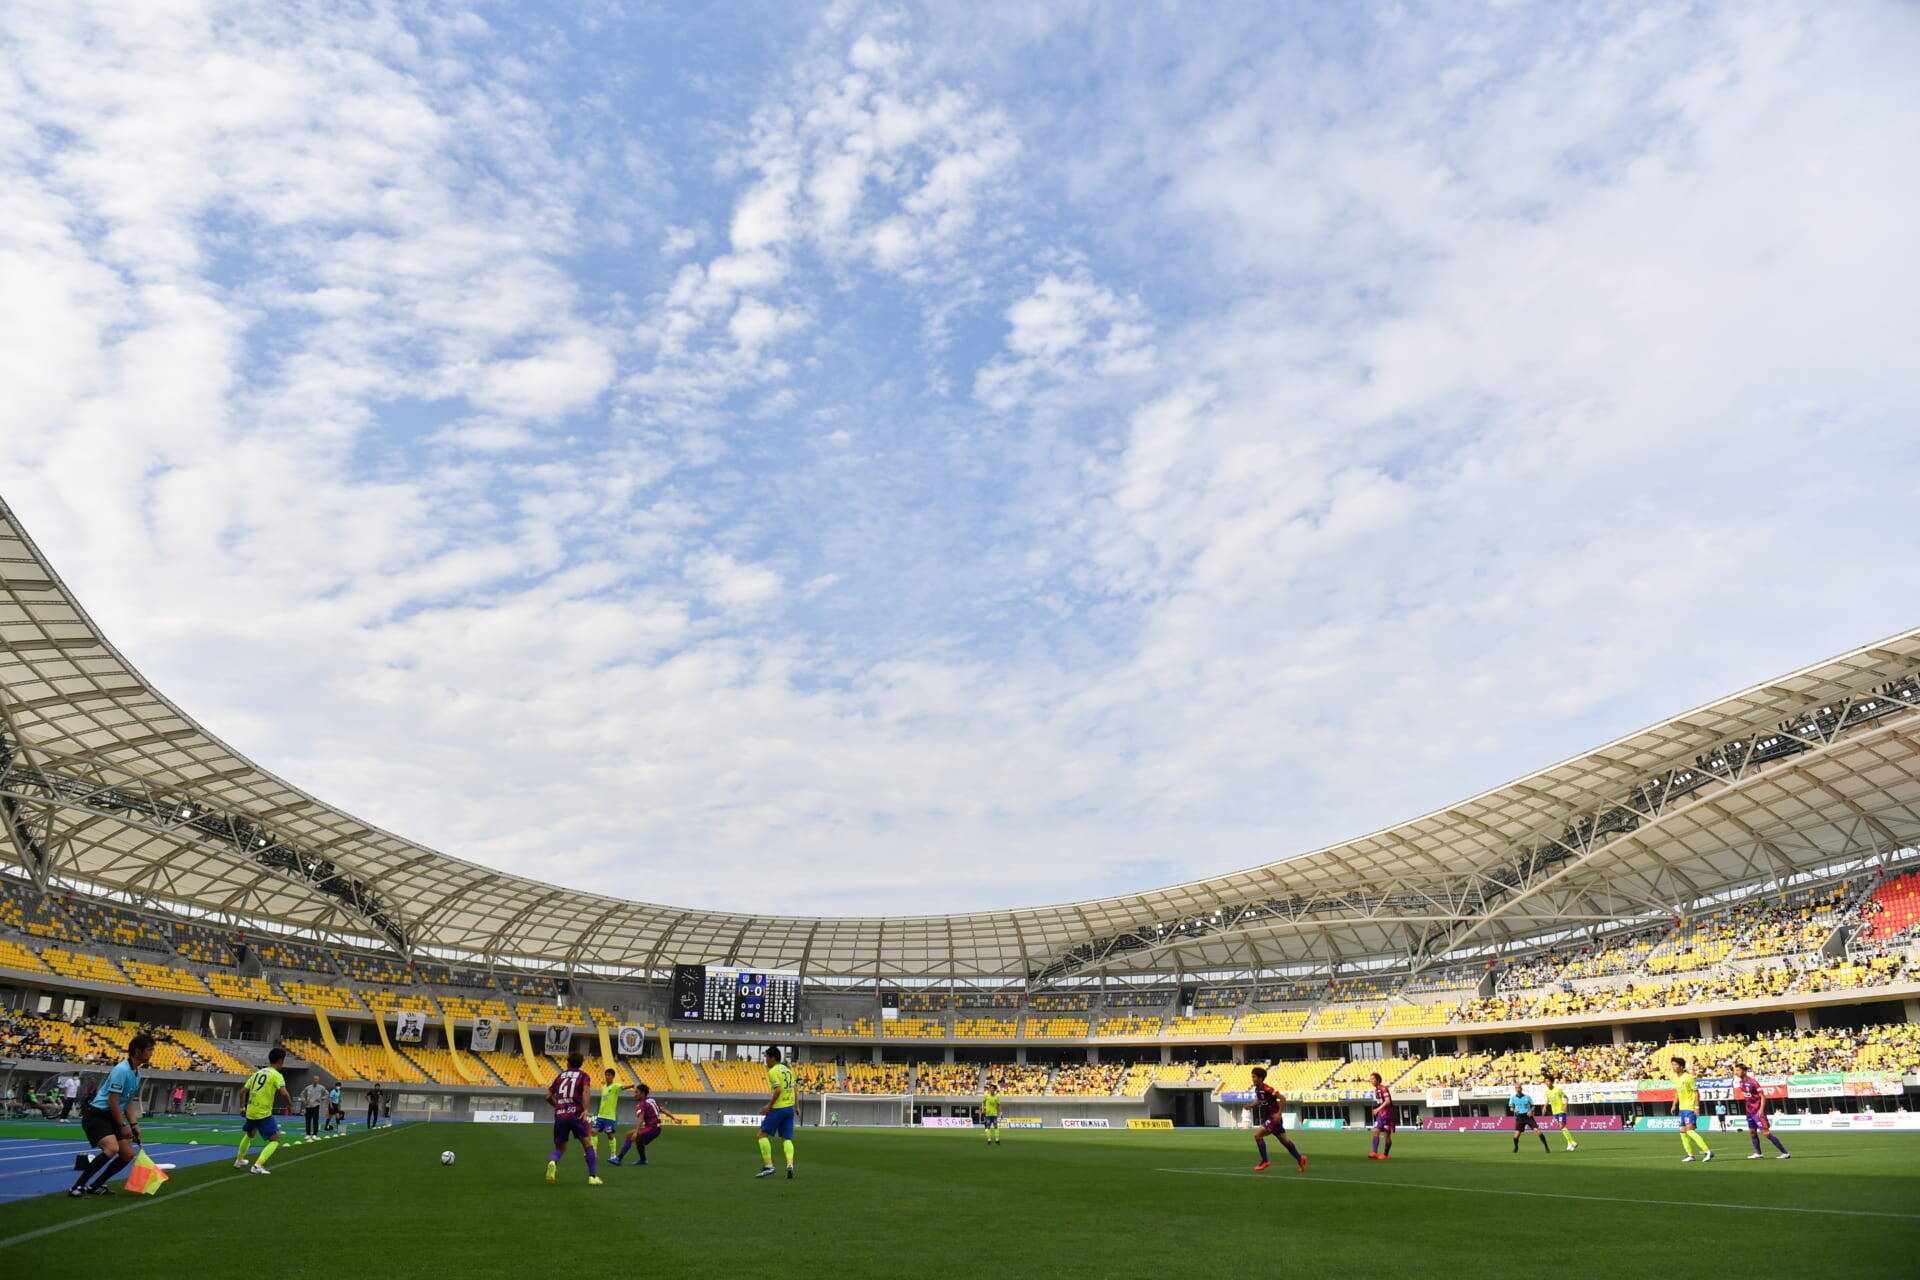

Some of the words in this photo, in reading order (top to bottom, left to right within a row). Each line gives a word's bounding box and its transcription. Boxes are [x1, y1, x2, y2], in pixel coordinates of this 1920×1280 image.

[251, 1072, 267, 1091] 19
[558, 1078, 577, 1099] 41
[1811, 1085, 1826, 1093] Cars
